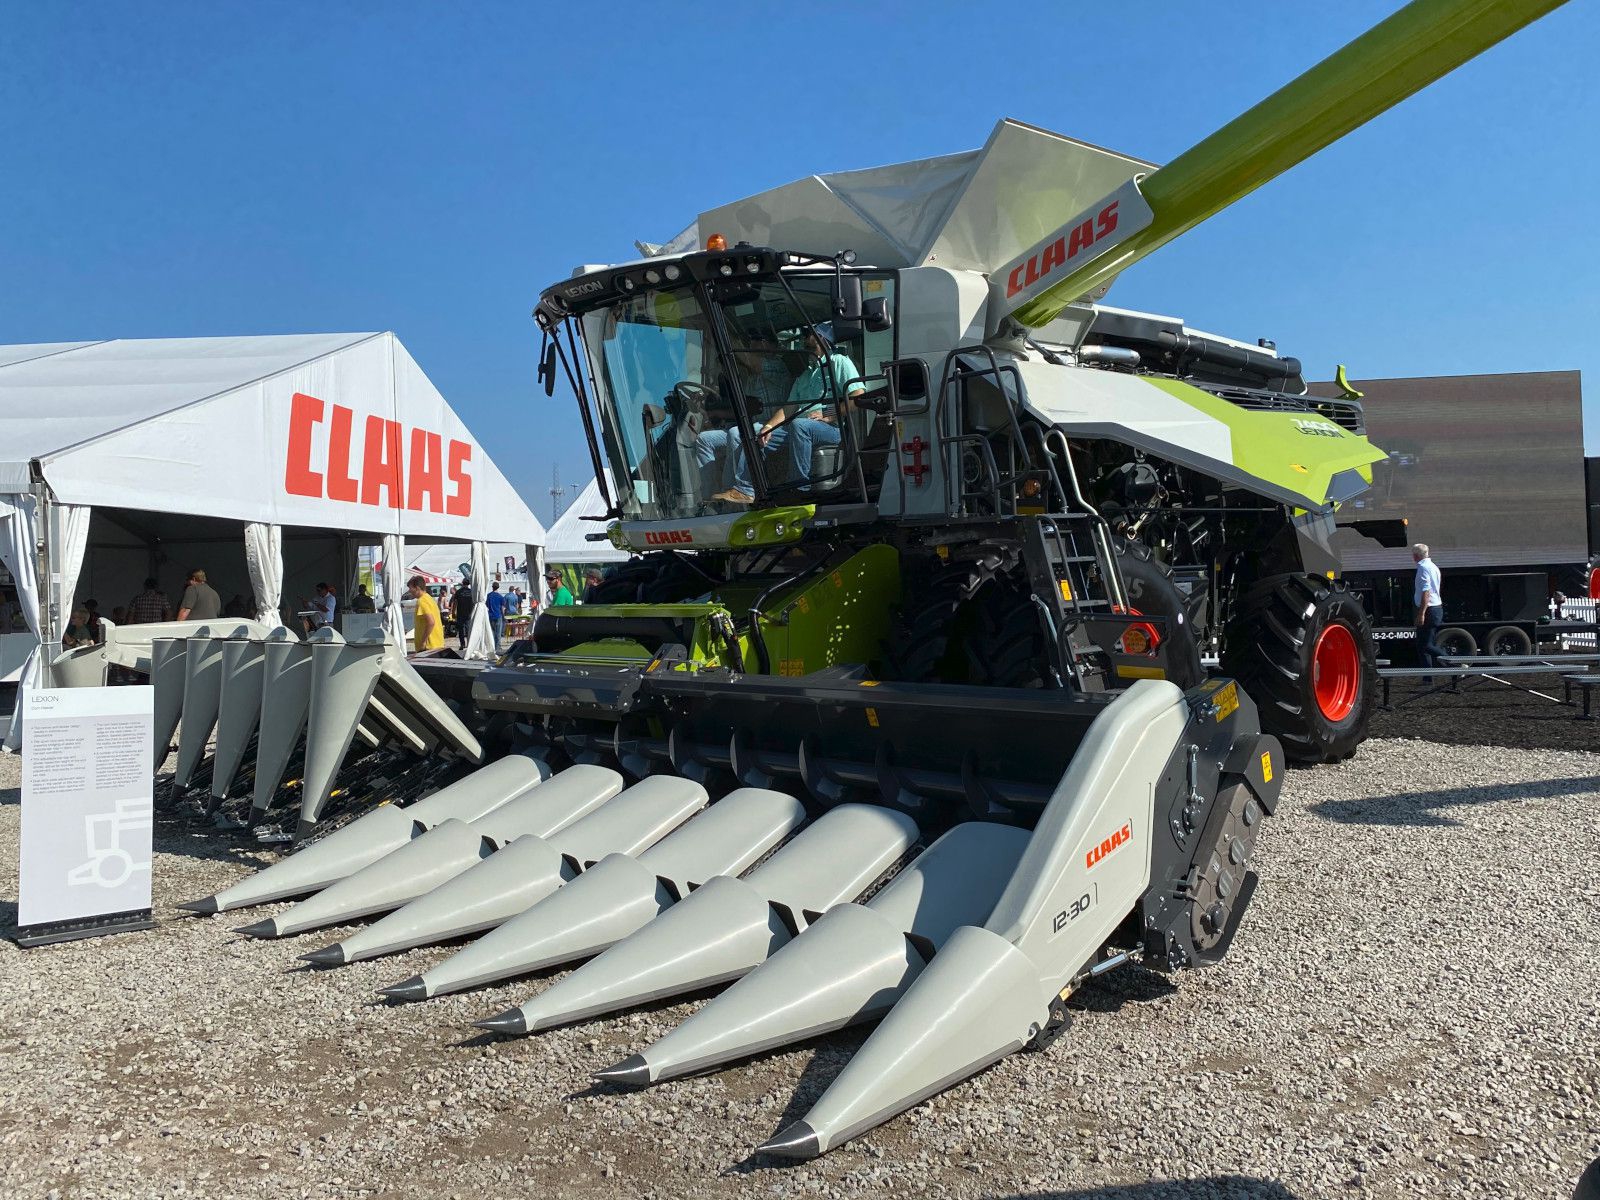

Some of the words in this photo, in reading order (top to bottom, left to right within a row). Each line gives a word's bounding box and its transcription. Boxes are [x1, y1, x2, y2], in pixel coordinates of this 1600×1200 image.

[1006, 200, 1120, 299] CLAAS
[565, 280, 604, 298] LEXION
[284, 392, 472, 518] CLAAS
[645, 529, 693, 545] CLAAS
[31, 695, 59, 703] LEXION
[1086, 823, 1130, 869] CLAAS
